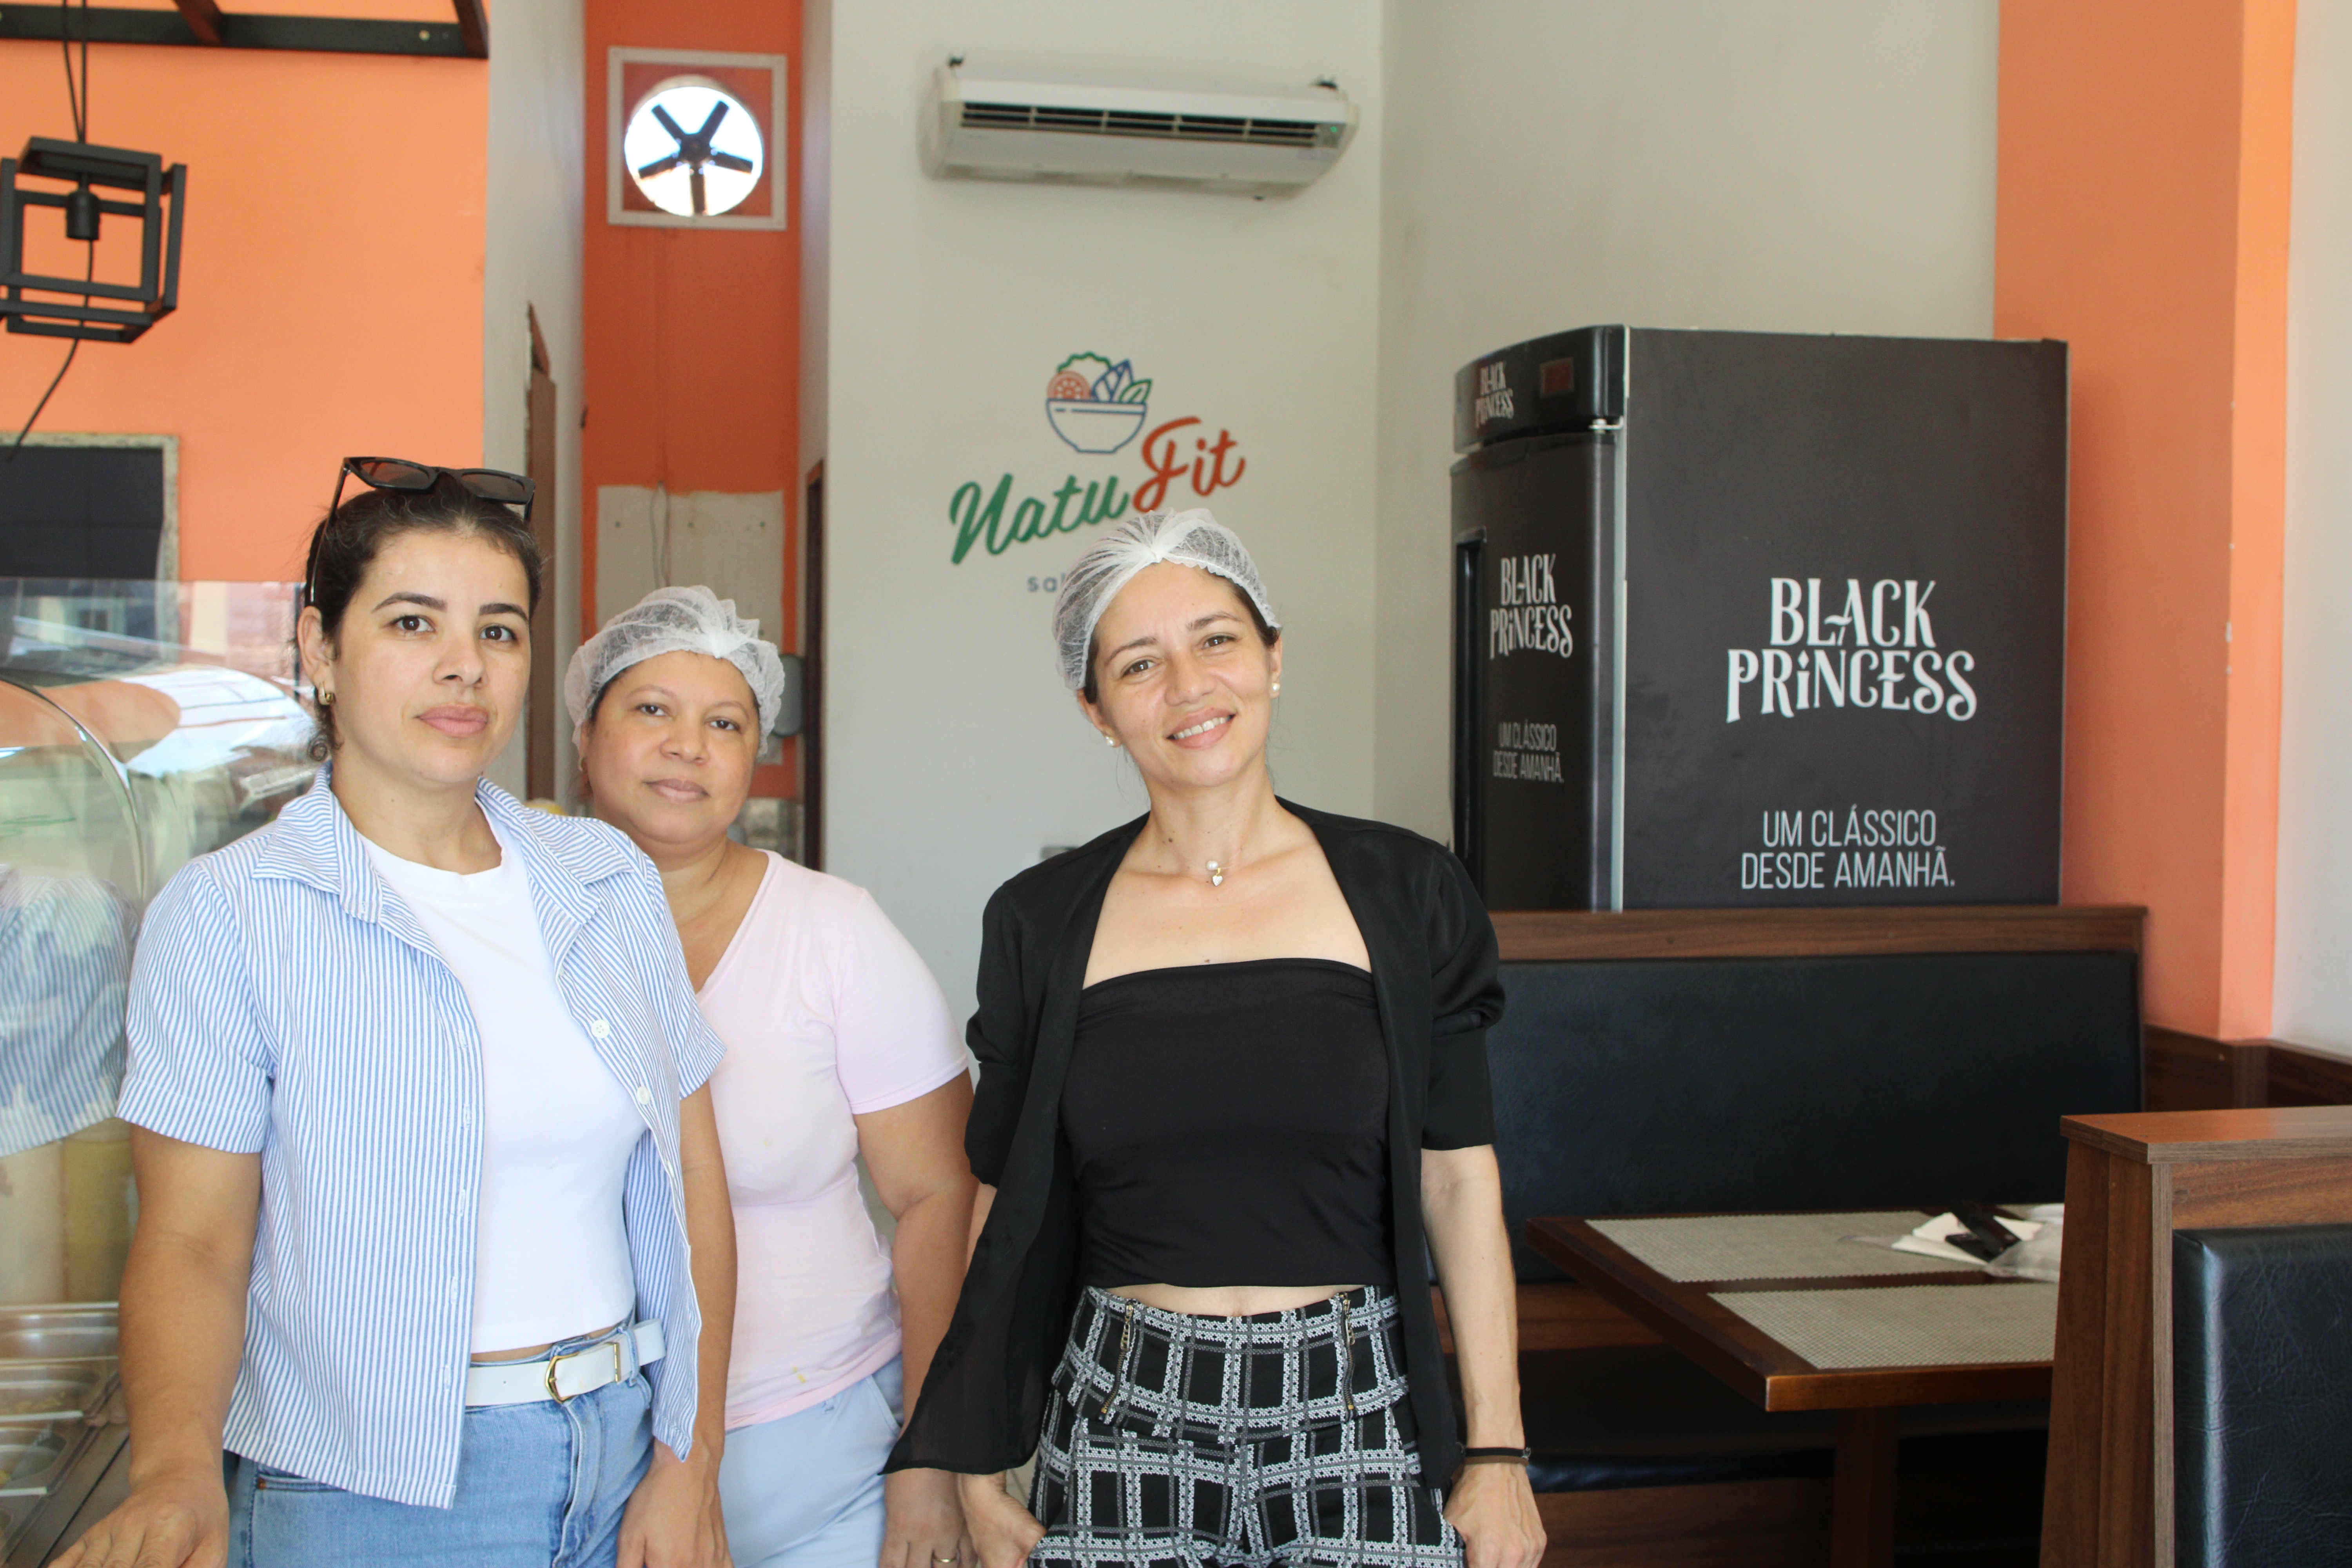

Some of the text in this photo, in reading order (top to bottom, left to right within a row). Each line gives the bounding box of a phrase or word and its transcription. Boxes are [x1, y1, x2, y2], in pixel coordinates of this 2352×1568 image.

[1500, 554, 1556, 606] BLACK
[1769, 577, 1936, 648] BLACK
[1763, 804, 1936, 848] UM CLÁSSICO
[1741, 846, 1955, 889] DESDE AMANHÃ.
